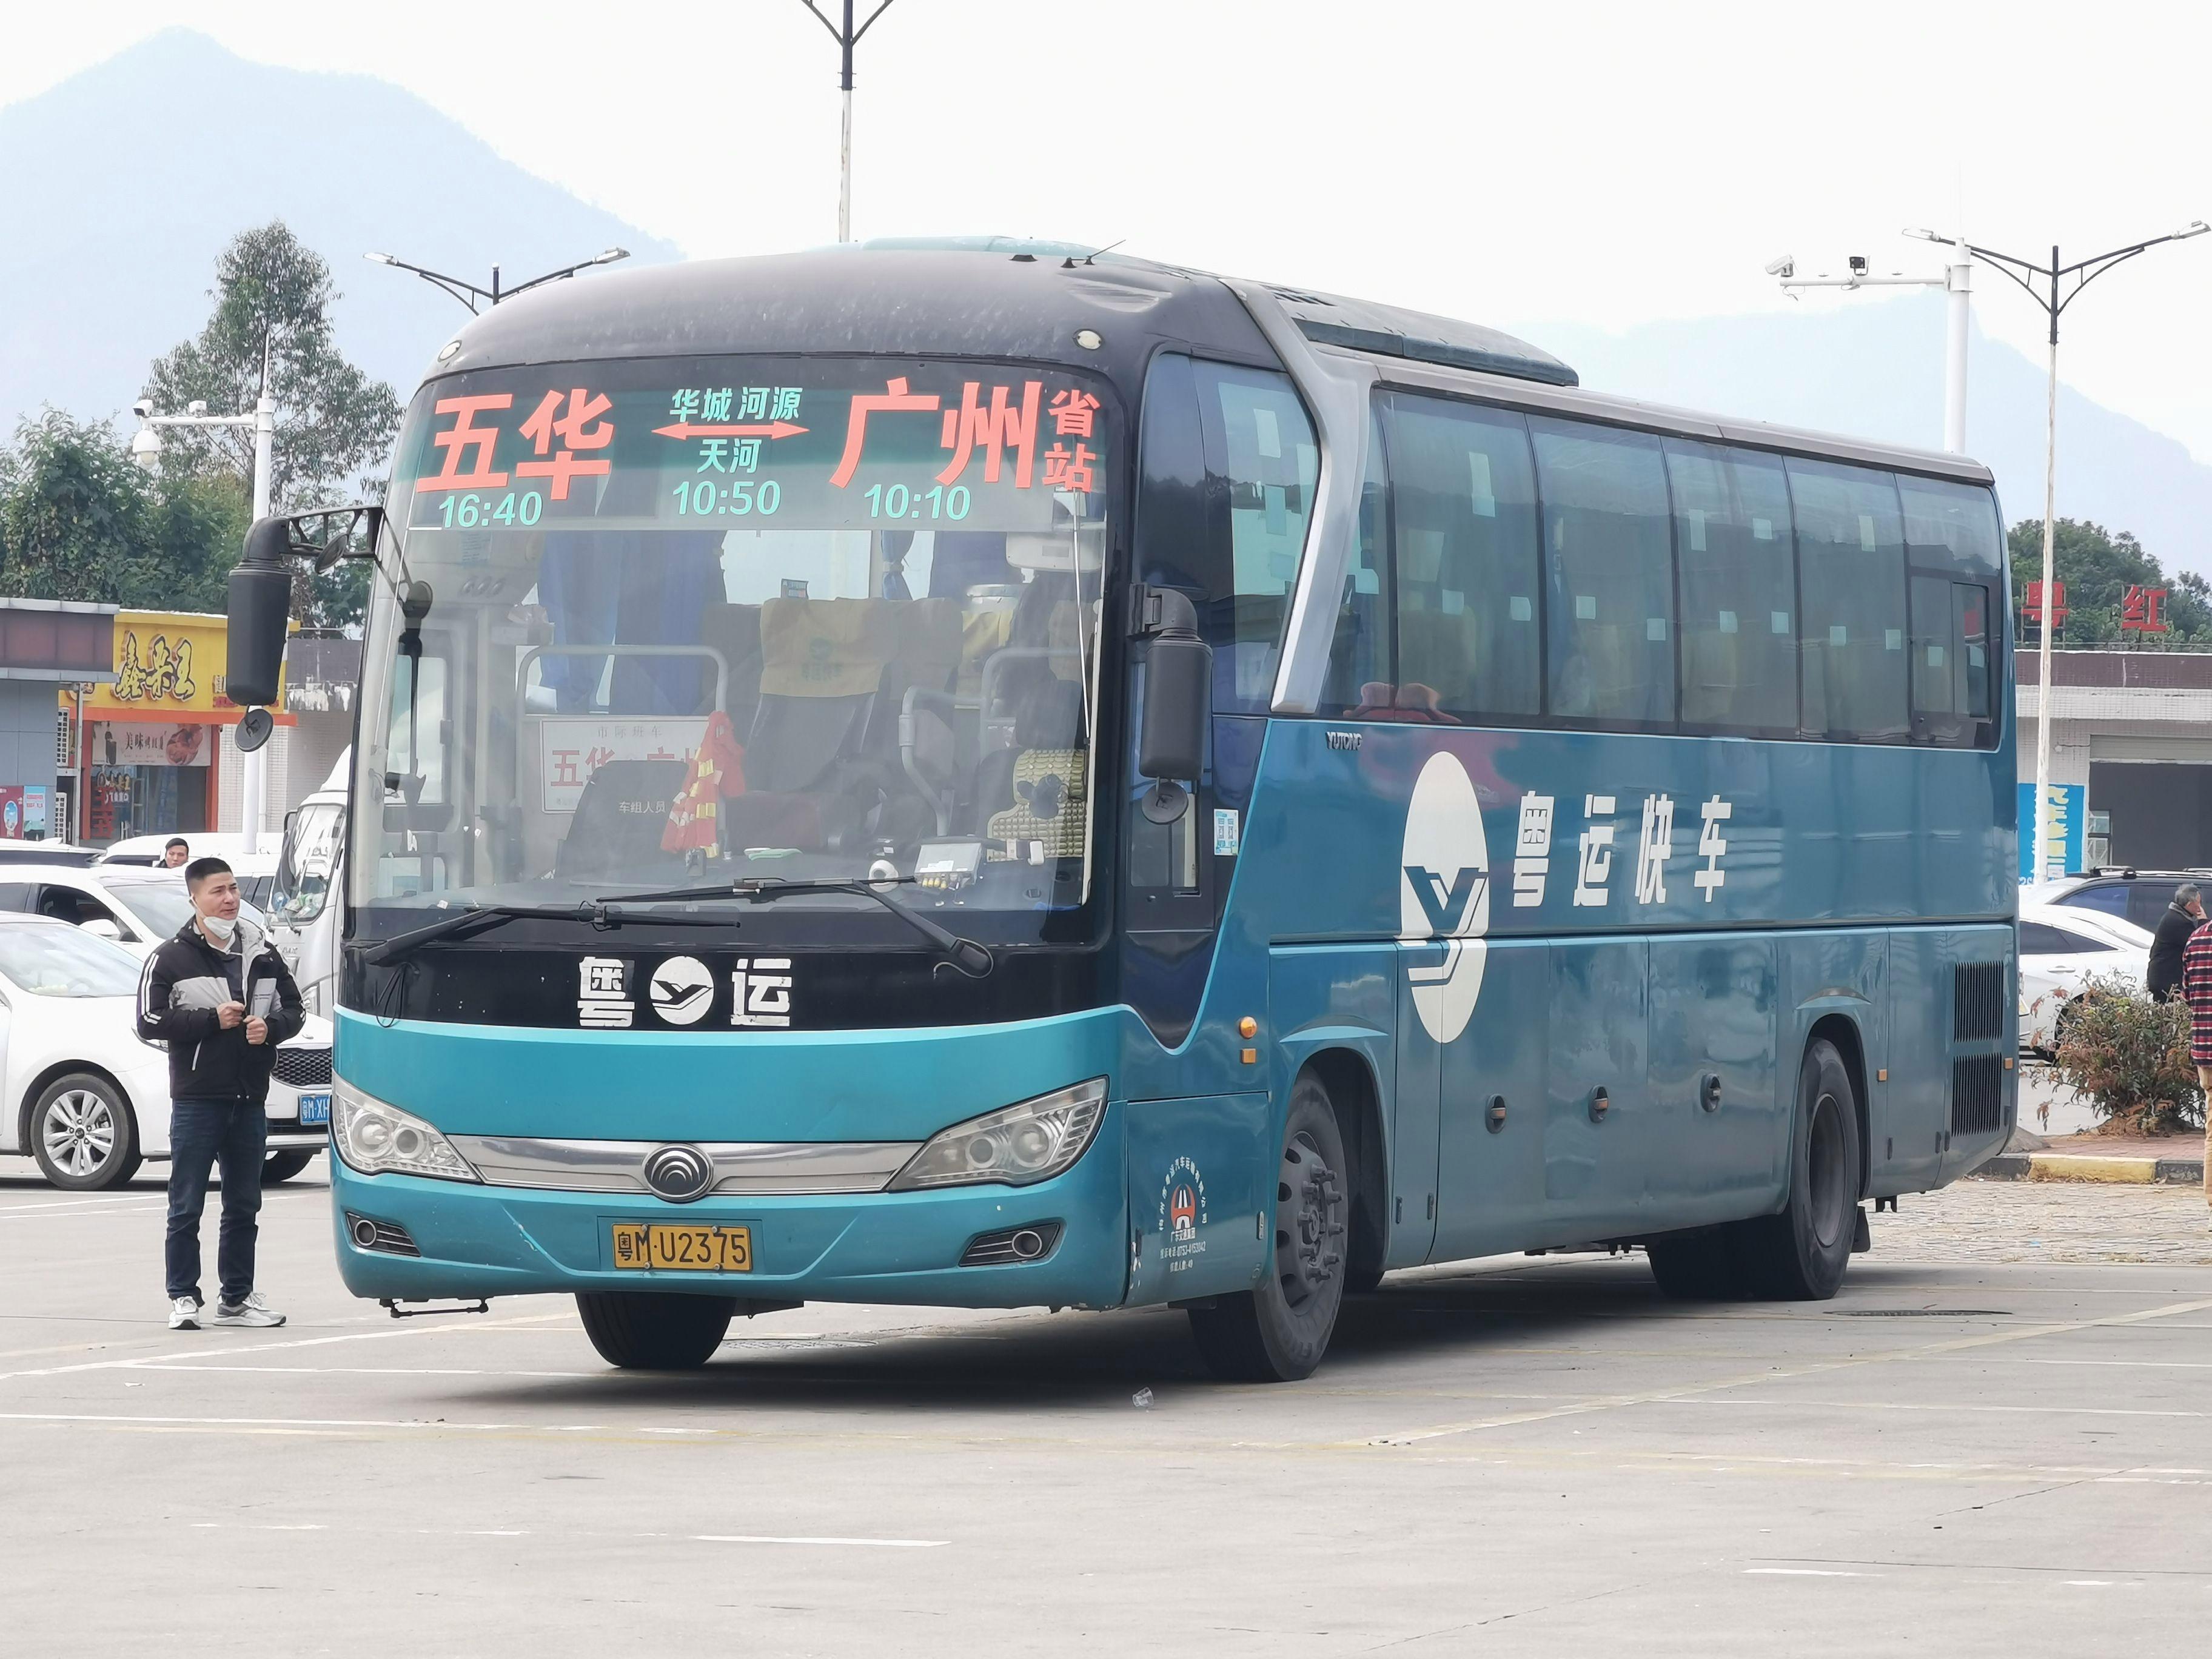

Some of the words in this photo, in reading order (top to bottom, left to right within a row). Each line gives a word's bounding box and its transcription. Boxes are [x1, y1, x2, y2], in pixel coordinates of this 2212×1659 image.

[669, 387, 732, 421] 华城
[737, 386, 803, 421] 河源
[417, 388, 614, 500] 五华
[829, 377, 1042, 488] 广州
[1042, 389, 1100, 493] 省站
[696, 438, 761, 474] 天河
[438, 491, 543, 529] 16:40
[672, 480, 780, 515] 10:50
[863, 483, 971, 521] 10:10
[597, 725, 662, 739] 市际班车
[1326, 731, 1362, 750] YUTONG
[618, 801, 666, 814] 车组人员
[1512, 790, 1732, 907] 粤运快车
[577, 956, 792, 1027] 粤运
